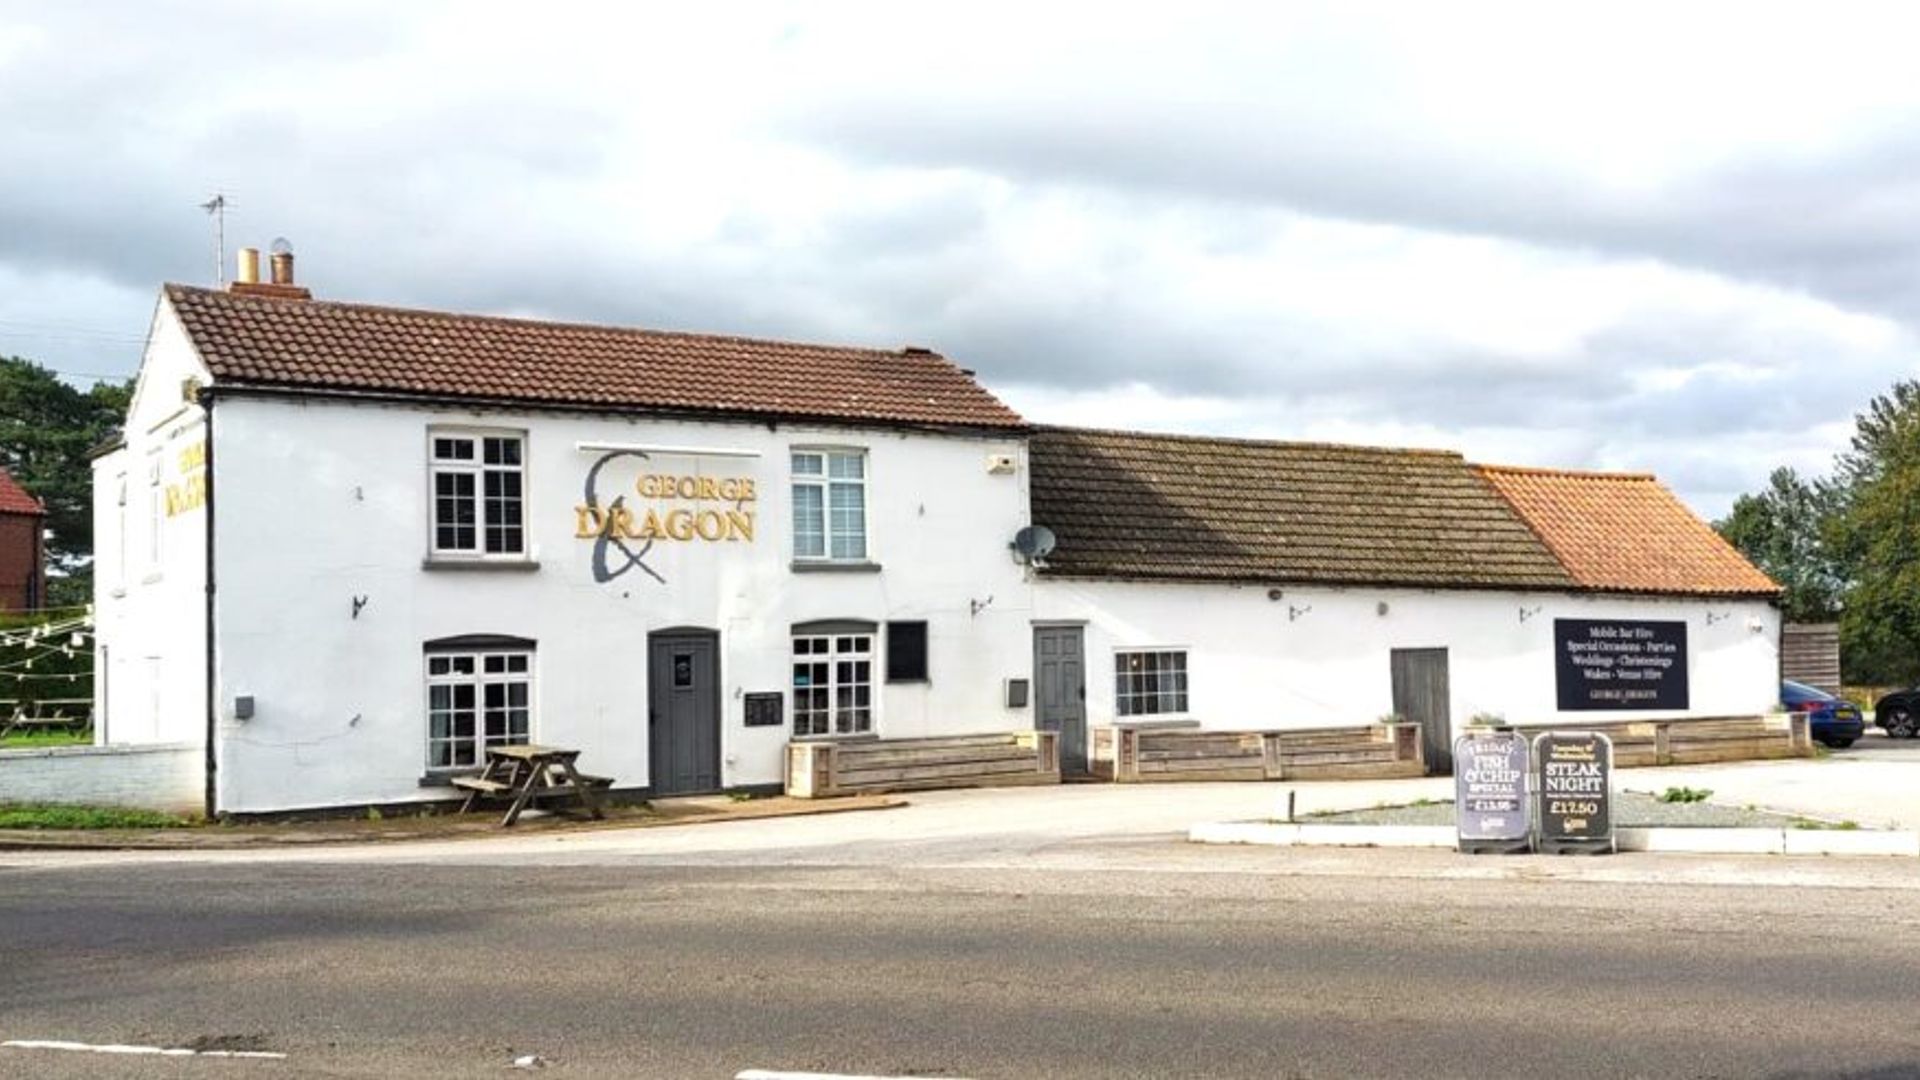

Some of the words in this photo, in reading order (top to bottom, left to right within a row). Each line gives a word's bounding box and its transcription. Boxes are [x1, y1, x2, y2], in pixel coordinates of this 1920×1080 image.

[637, 474, 757, 501] GEORGE
[574, 504, 755, 542] DRAGON
[1589, 627, 1618, 638] Mobile
[1619, 628, 1633, 638] Bar
[1635, 628, 1654, 638] Hire
[1567, 641, 1598, 653] Special
[1599, 641, 1641, 652] Occasions
[1647, 641, 1677, 653] Parties
[1571, 654, 1614, 667] Weddings
[1619, 654, 1673, 667] Christenings
[1583, 668, 1611, 679] Wakes
[1616, 669, 1642, 679] Venue
[1643, 669, 1663, 680] Hire
[1545, 762, 1603, 776] STEAK
[1469, 783, 1516, 793] SPECIAL
[1545, 777, 1604, 792] NIGHT
[1550, 801, 1598, 814] £17.50
